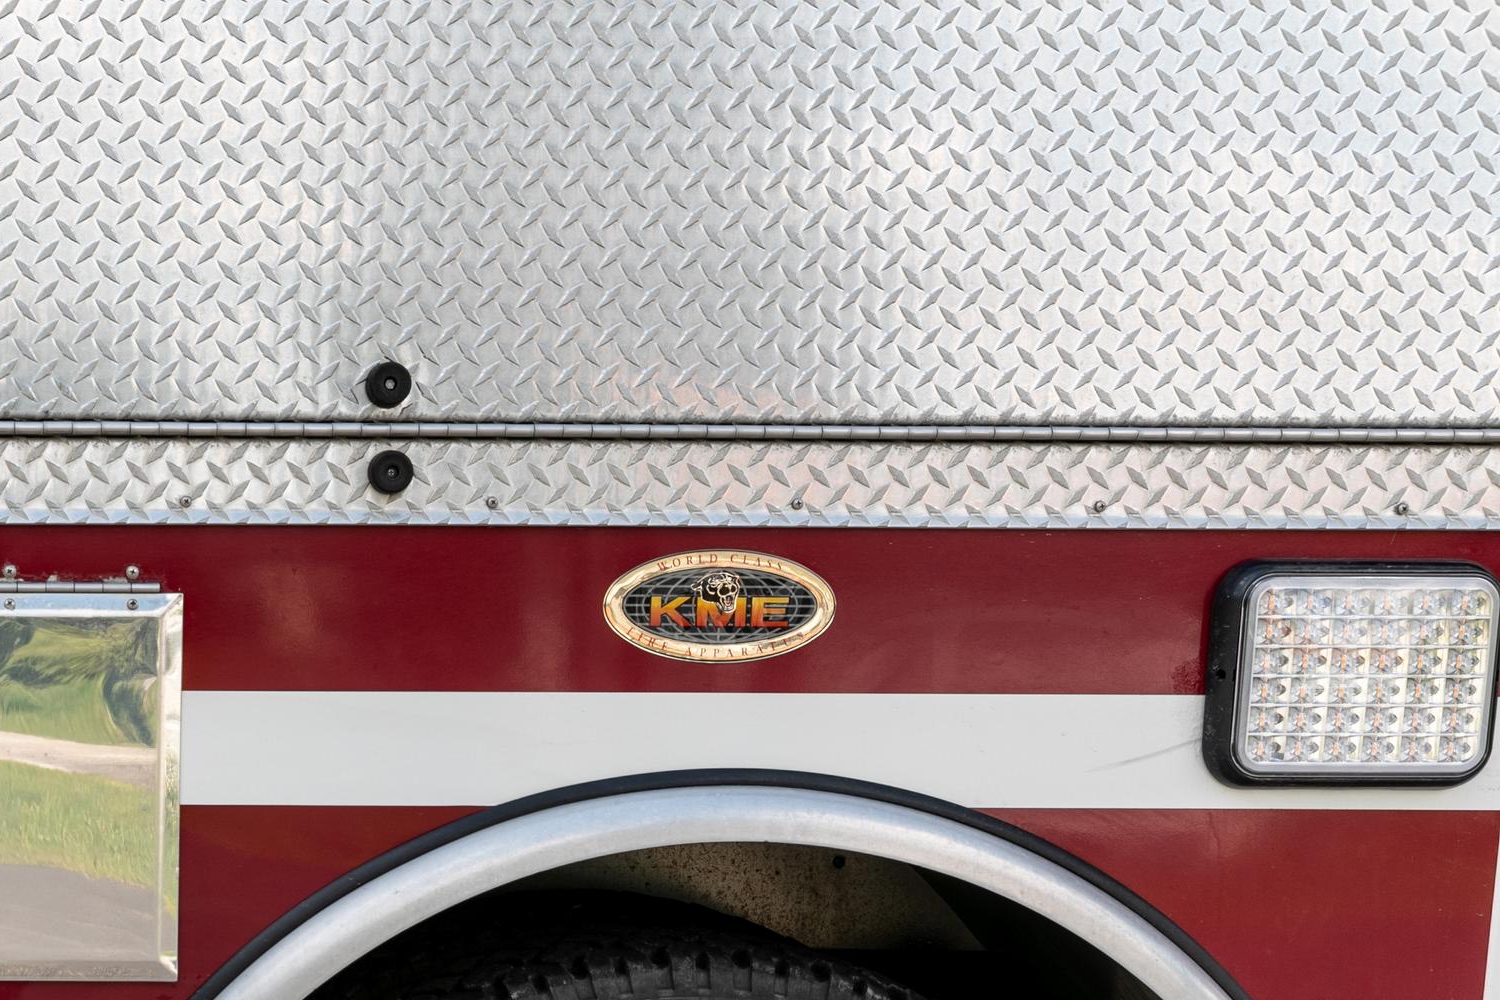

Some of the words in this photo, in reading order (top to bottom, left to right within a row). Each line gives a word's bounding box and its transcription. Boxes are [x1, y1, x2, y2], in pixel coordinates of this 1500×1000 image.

[656, 552, 719, 572] WORLD
[730, 552, 783, 572] CLASS
[649, 596, 789, 628] KME
[626, 626, 669, 651] FIRE
